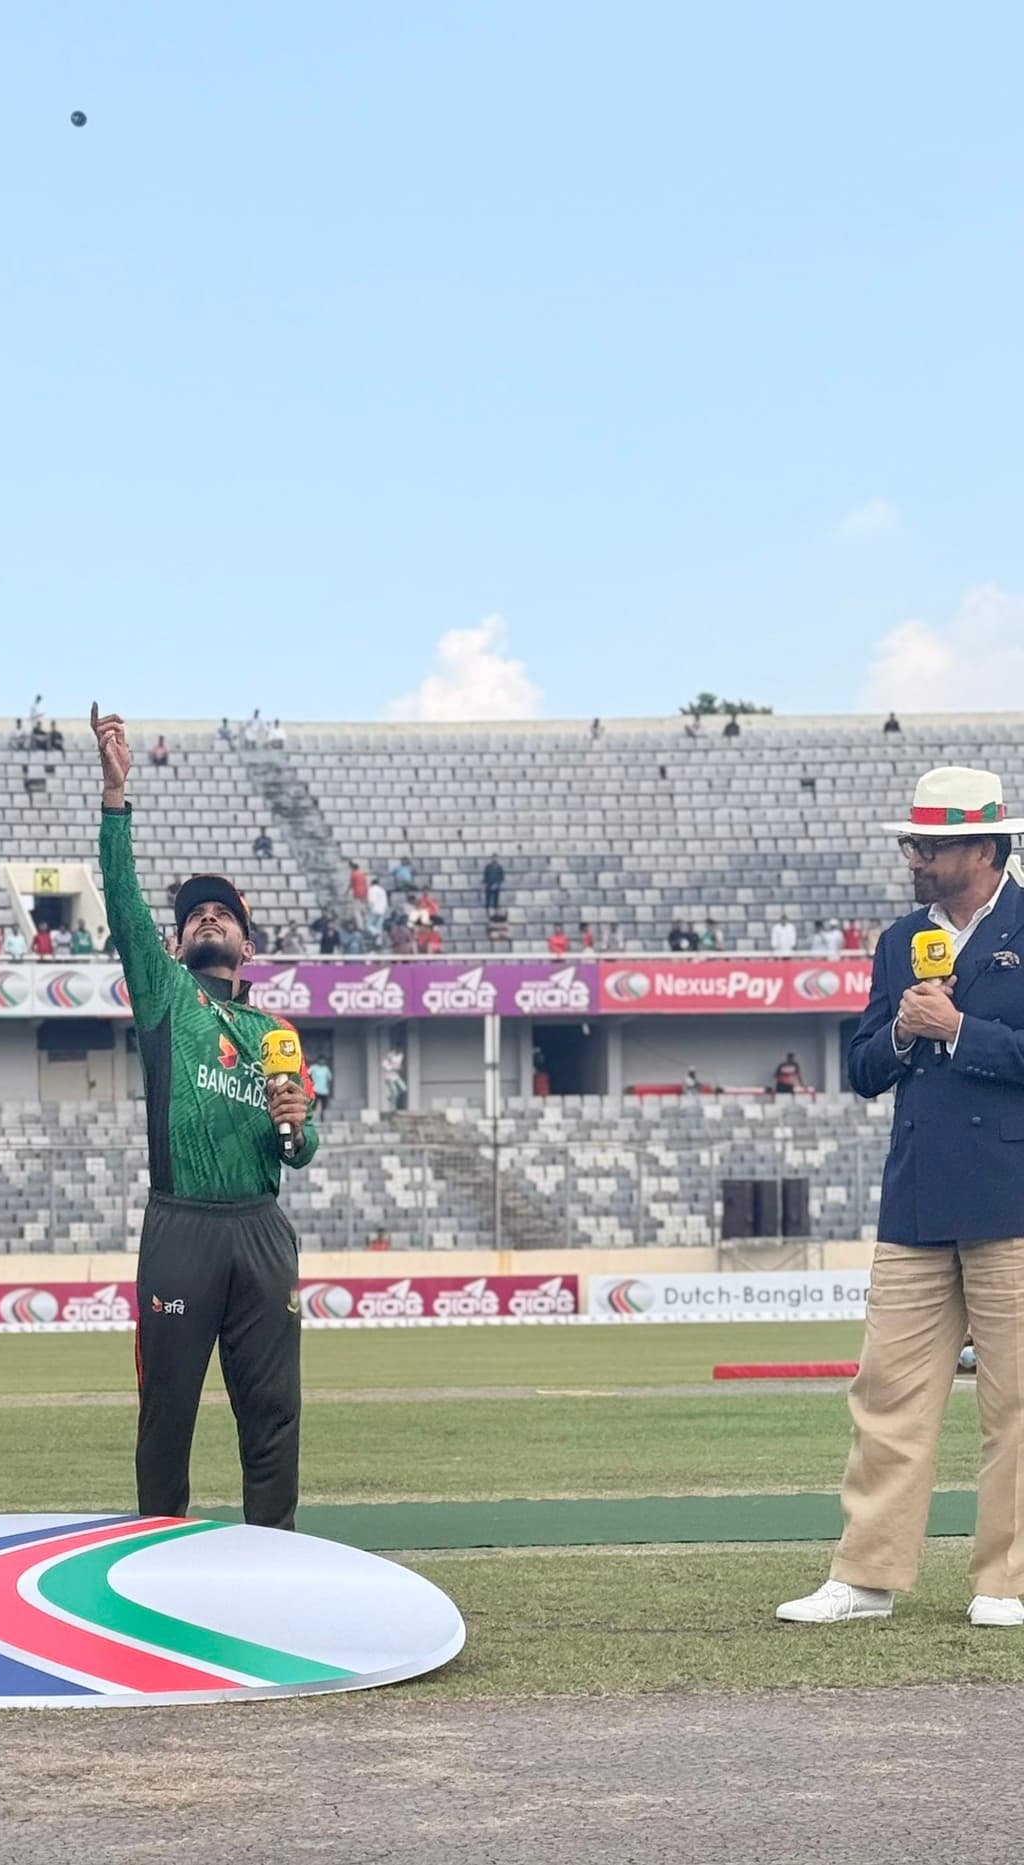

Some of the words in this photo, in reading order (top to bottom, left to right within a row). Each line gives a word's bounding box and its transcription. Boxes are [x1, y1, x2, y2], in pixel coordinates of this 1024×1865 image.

[41, 874, 53, 888] K
[655, 972, 783, 1005] NexusPay
[197, 1063, 269, 1111] BANGLADE
[664, 1285, 824, 1306] Dutch-Bangla
[164, 1299, 185, 1315] রবি
